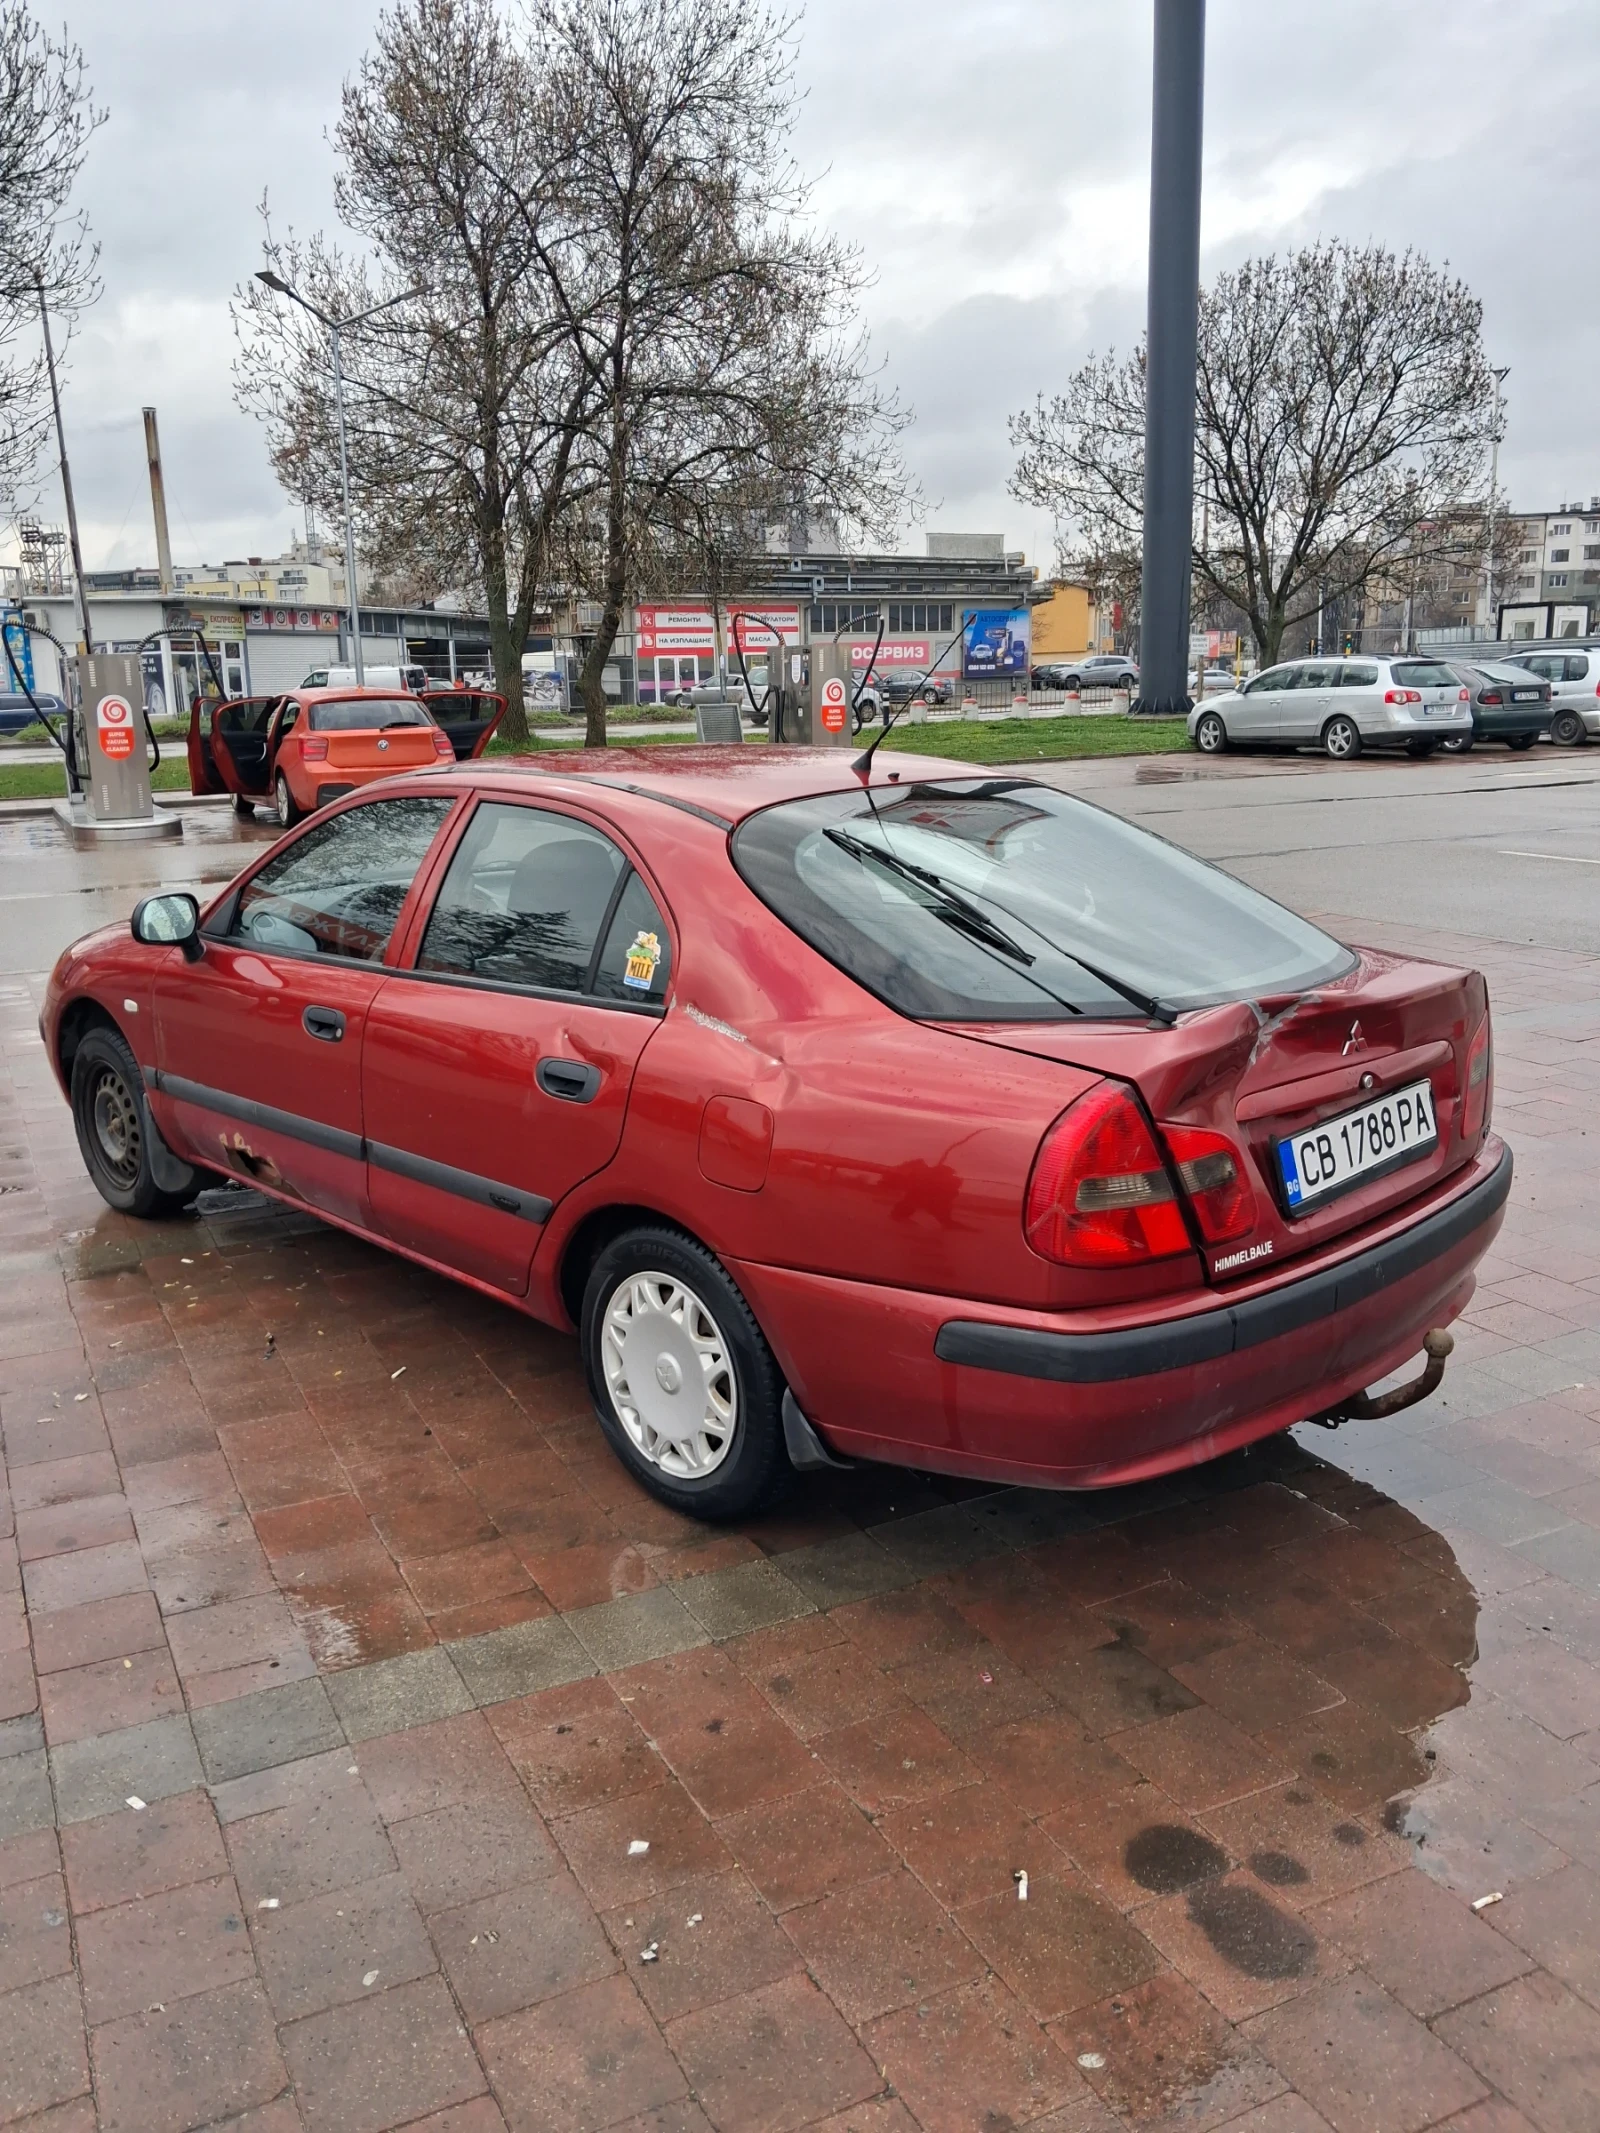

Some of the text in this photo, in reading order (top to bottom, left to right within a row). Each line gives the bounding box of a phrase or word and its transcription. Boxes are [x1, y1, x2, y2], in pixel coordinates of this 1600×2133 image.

[851, 646, 924, 660] ОСЕРВИЗ
[629, 961, 652, 979] MILF
[1300, 1092, 1431, 1187] CB 1788 PA
[1287, 1179, 1299, 1196] BG
[1214, 1240, 1274, 1273] HIMMELBAUE
